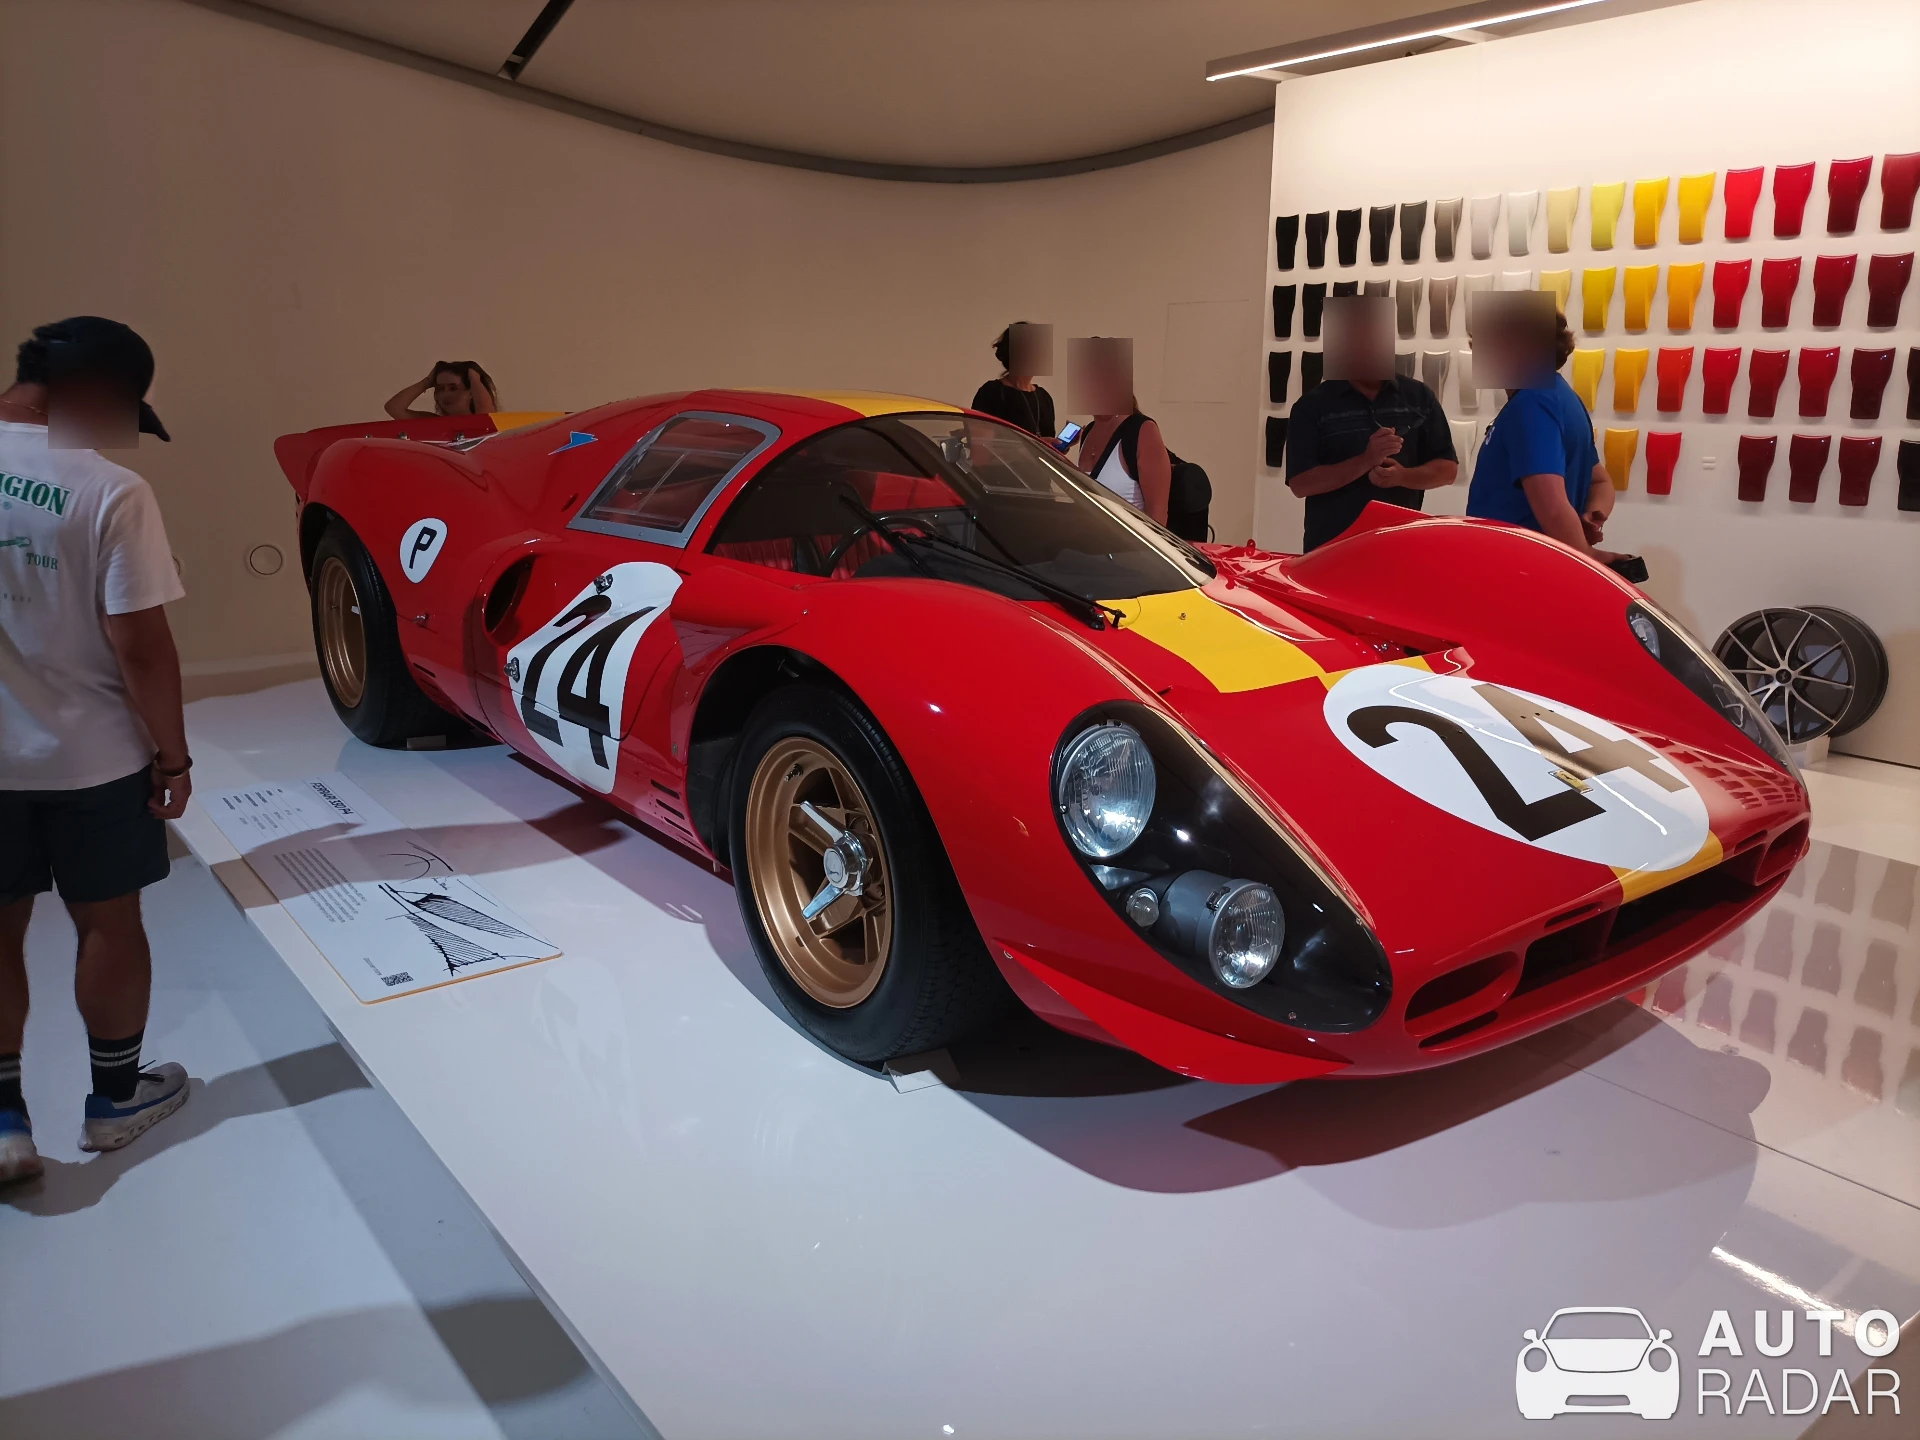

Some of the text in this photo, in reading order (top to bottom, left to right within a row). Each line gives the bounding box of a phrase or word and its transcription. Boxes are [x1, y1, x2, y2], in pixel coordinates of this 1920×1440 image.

[26, 552, 59, 571] TOUR
[409, 526, 437, 569] P
[520, 594, 658, 770] 24
[1346, 683, 1690, 842] 24
